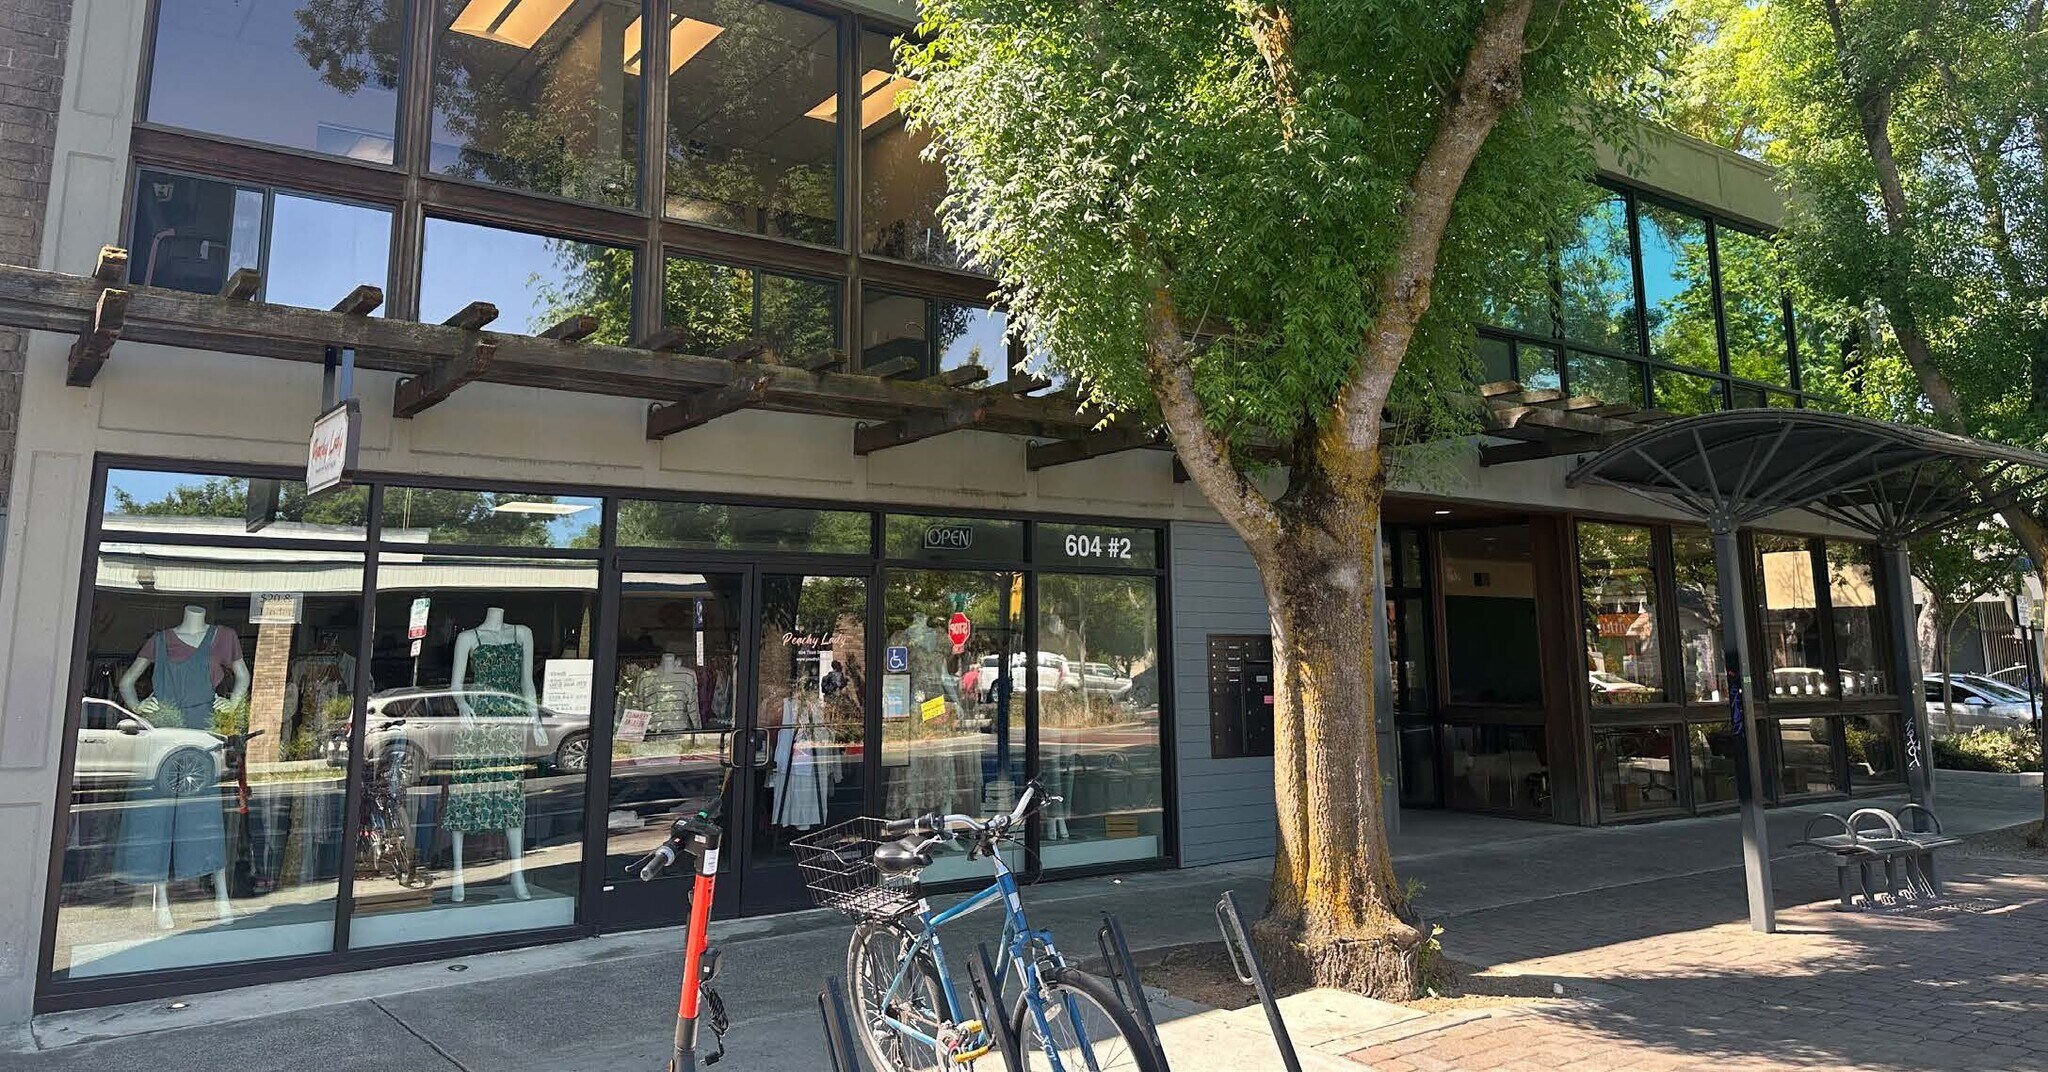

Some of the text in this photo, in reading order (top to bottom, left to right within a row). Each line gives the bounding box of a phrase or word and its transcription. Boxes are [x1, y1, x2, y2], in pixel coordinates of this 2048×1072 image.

[928, 528, 970, 546] OPEN
[1065, 534, 1132, 559] 604 #2
[260, 593, 281, 603] $20
[782, 632, 847, 648] Peachy Lady
